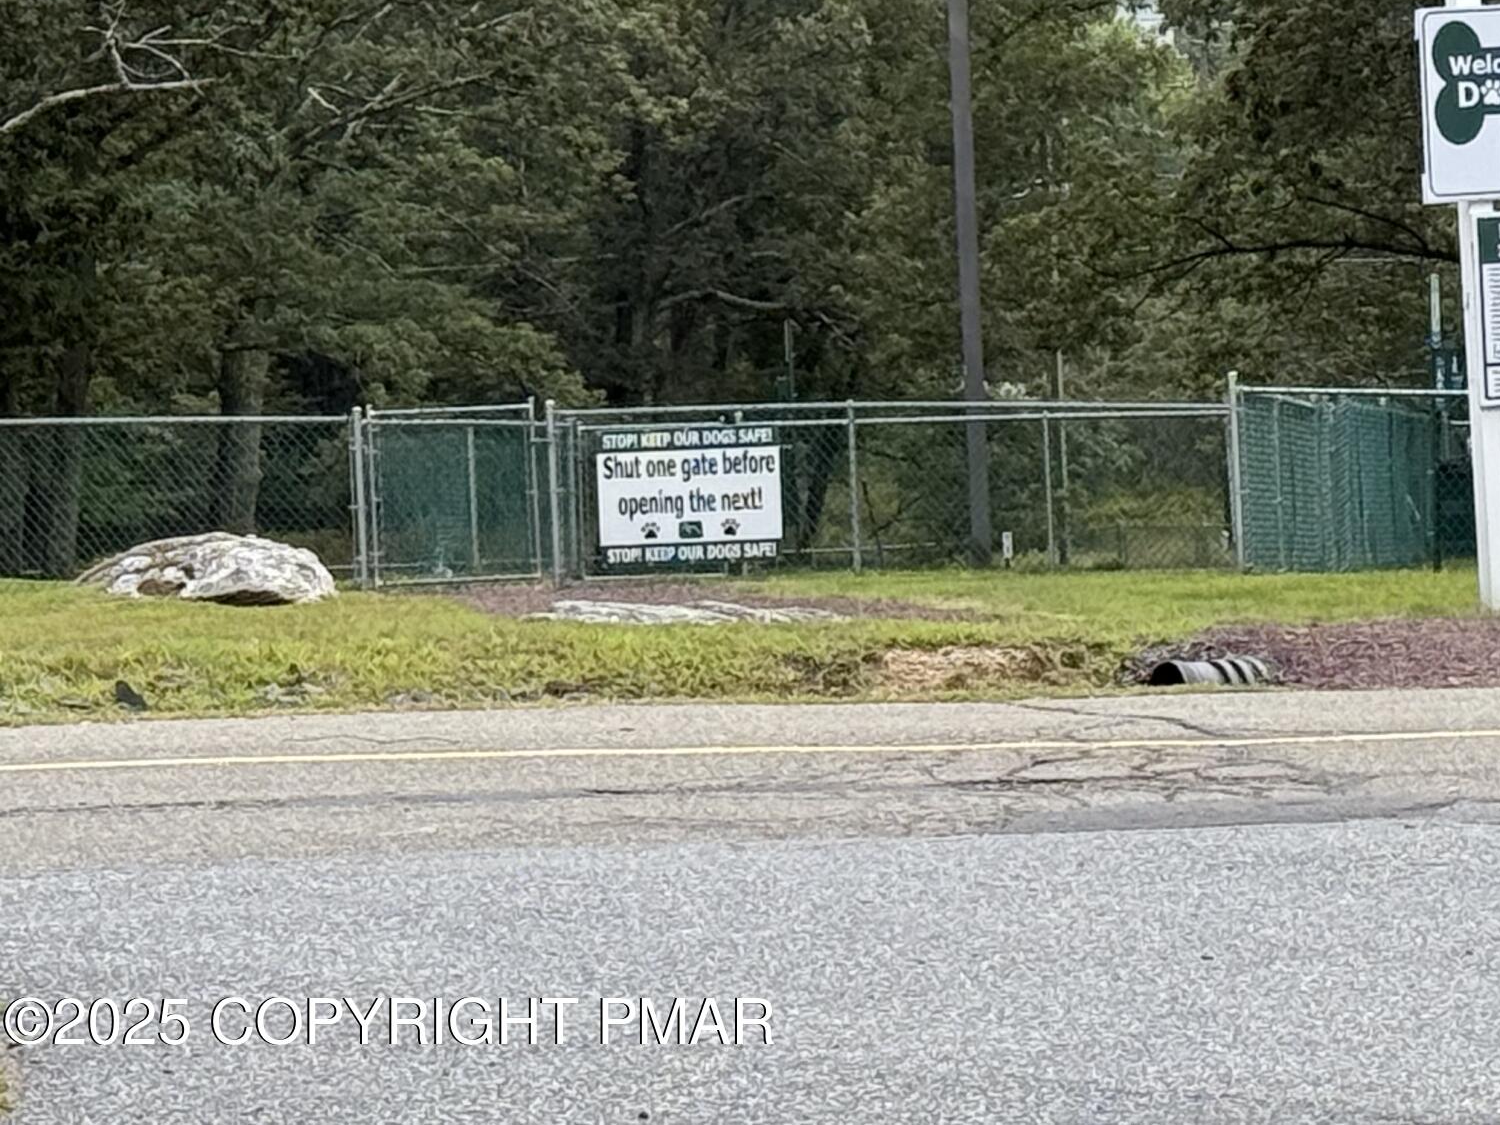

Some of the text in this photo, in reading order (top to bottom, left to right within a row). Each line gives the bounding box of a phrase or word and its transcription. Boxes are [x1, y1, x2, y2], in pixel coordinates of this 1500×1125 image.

[602, 427, 773, 449] STOP! KEEP OUR DOGS SAFE!
[603, 450, 775, 482] Shut one gate before
[618, 486, 763, 521] opening the next!
[607, 542, 777, 564] STOP! KEEP OUR DOGS SAFE!
